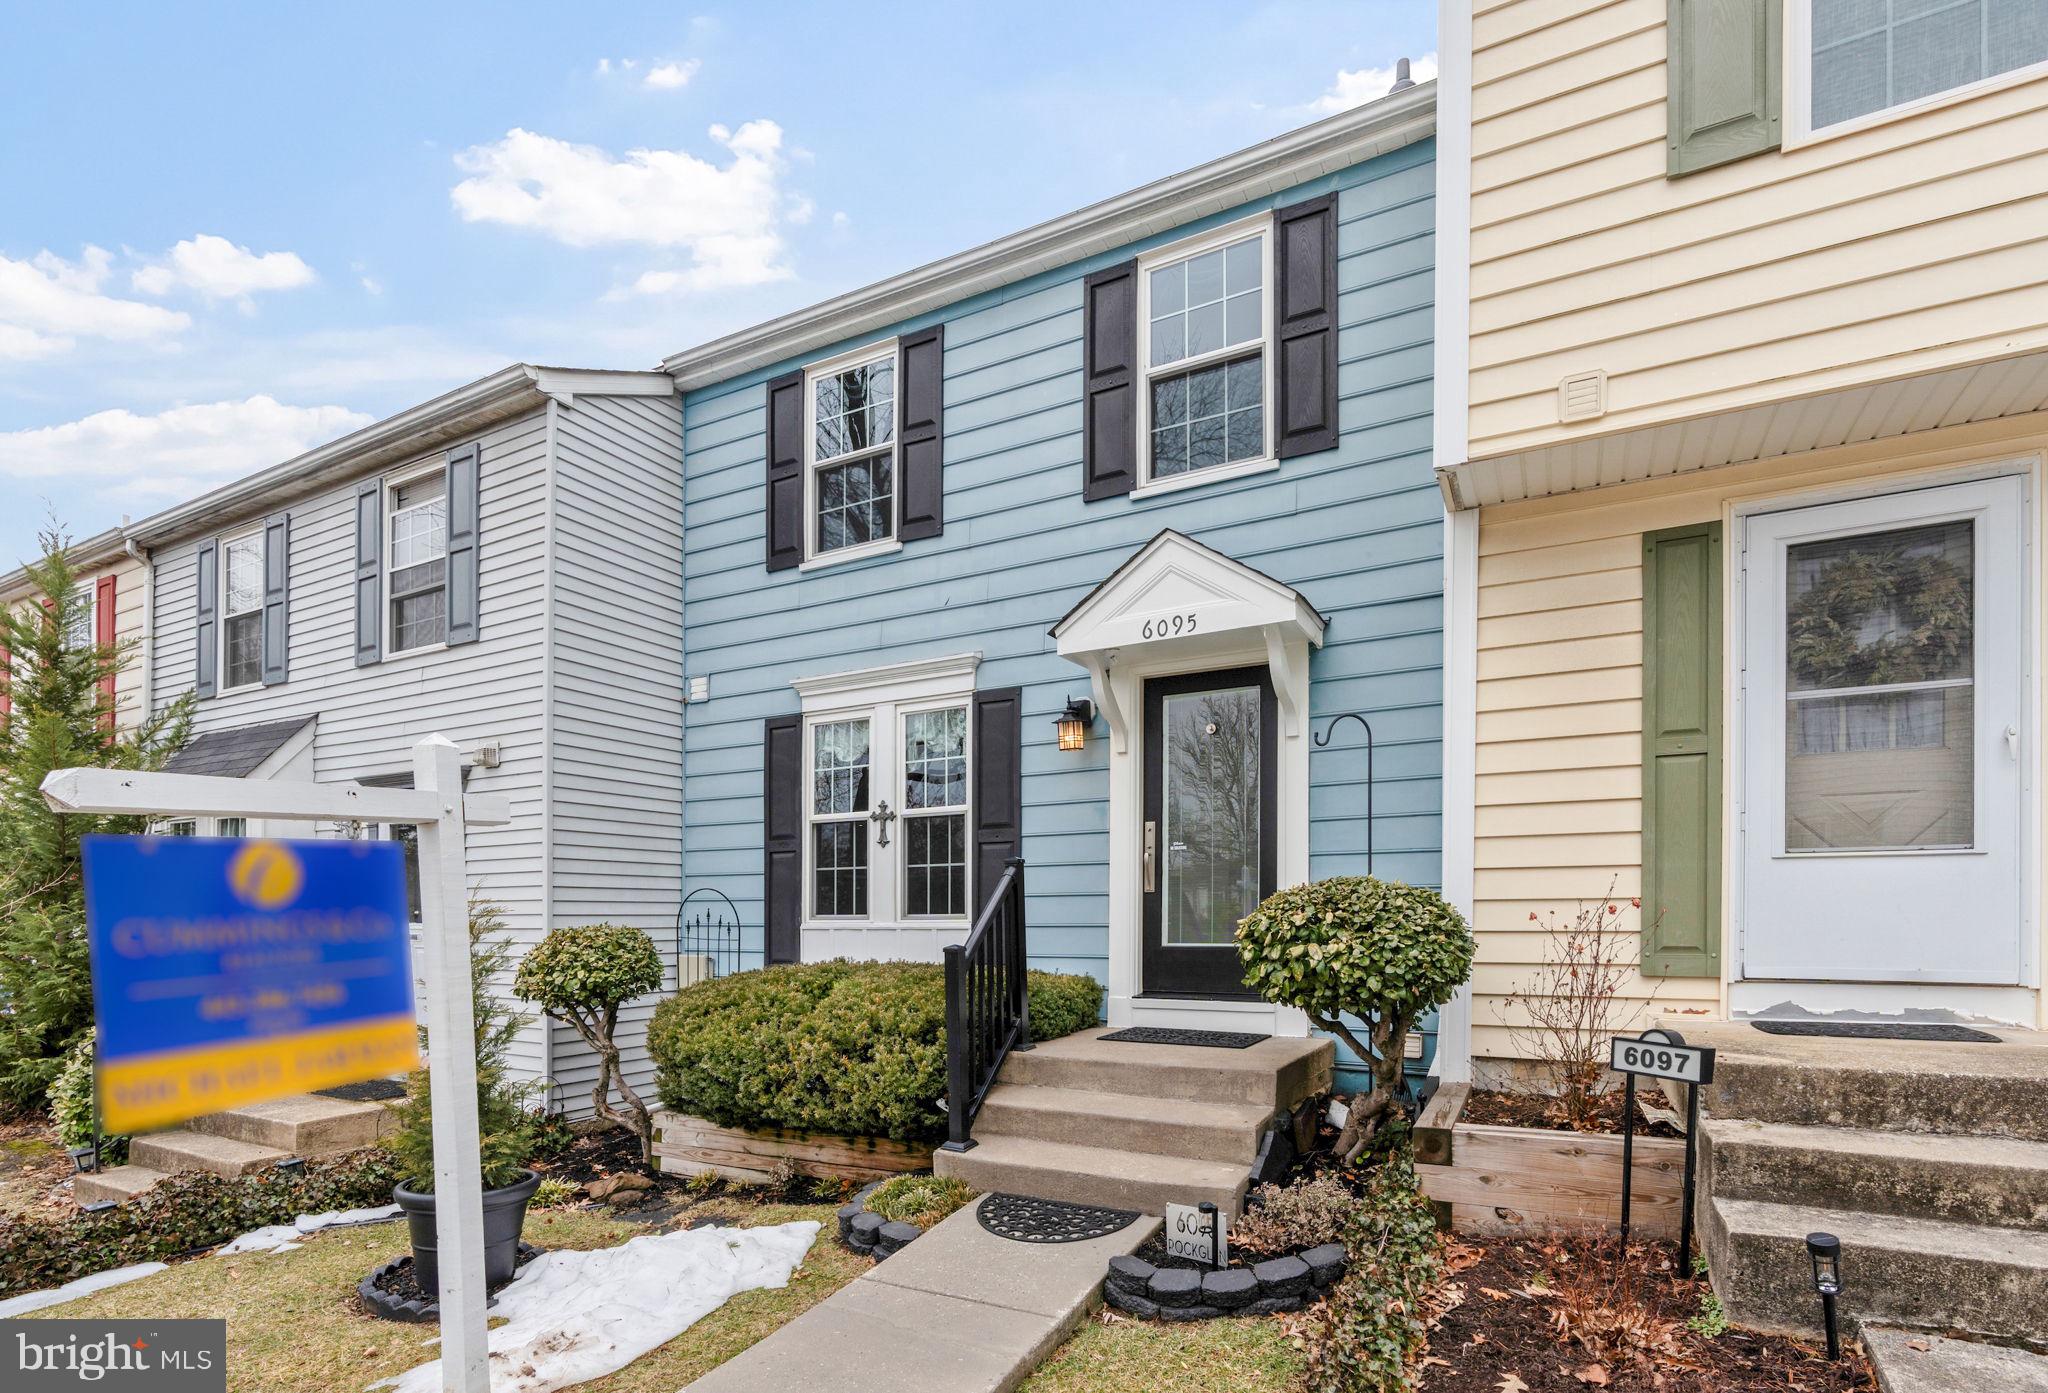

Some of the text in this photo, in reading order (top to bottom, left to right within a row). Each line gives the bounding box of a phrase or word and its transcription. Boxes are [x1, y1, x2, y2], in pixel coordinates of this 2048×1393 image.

[1142, 613, 1197, 639] 6095
[1624, 1046, 1690, 1073] 6097
[1177, 1211, 1216, 1238] 60
[1168, 1238, 1227, 1263] ROCKGLN
